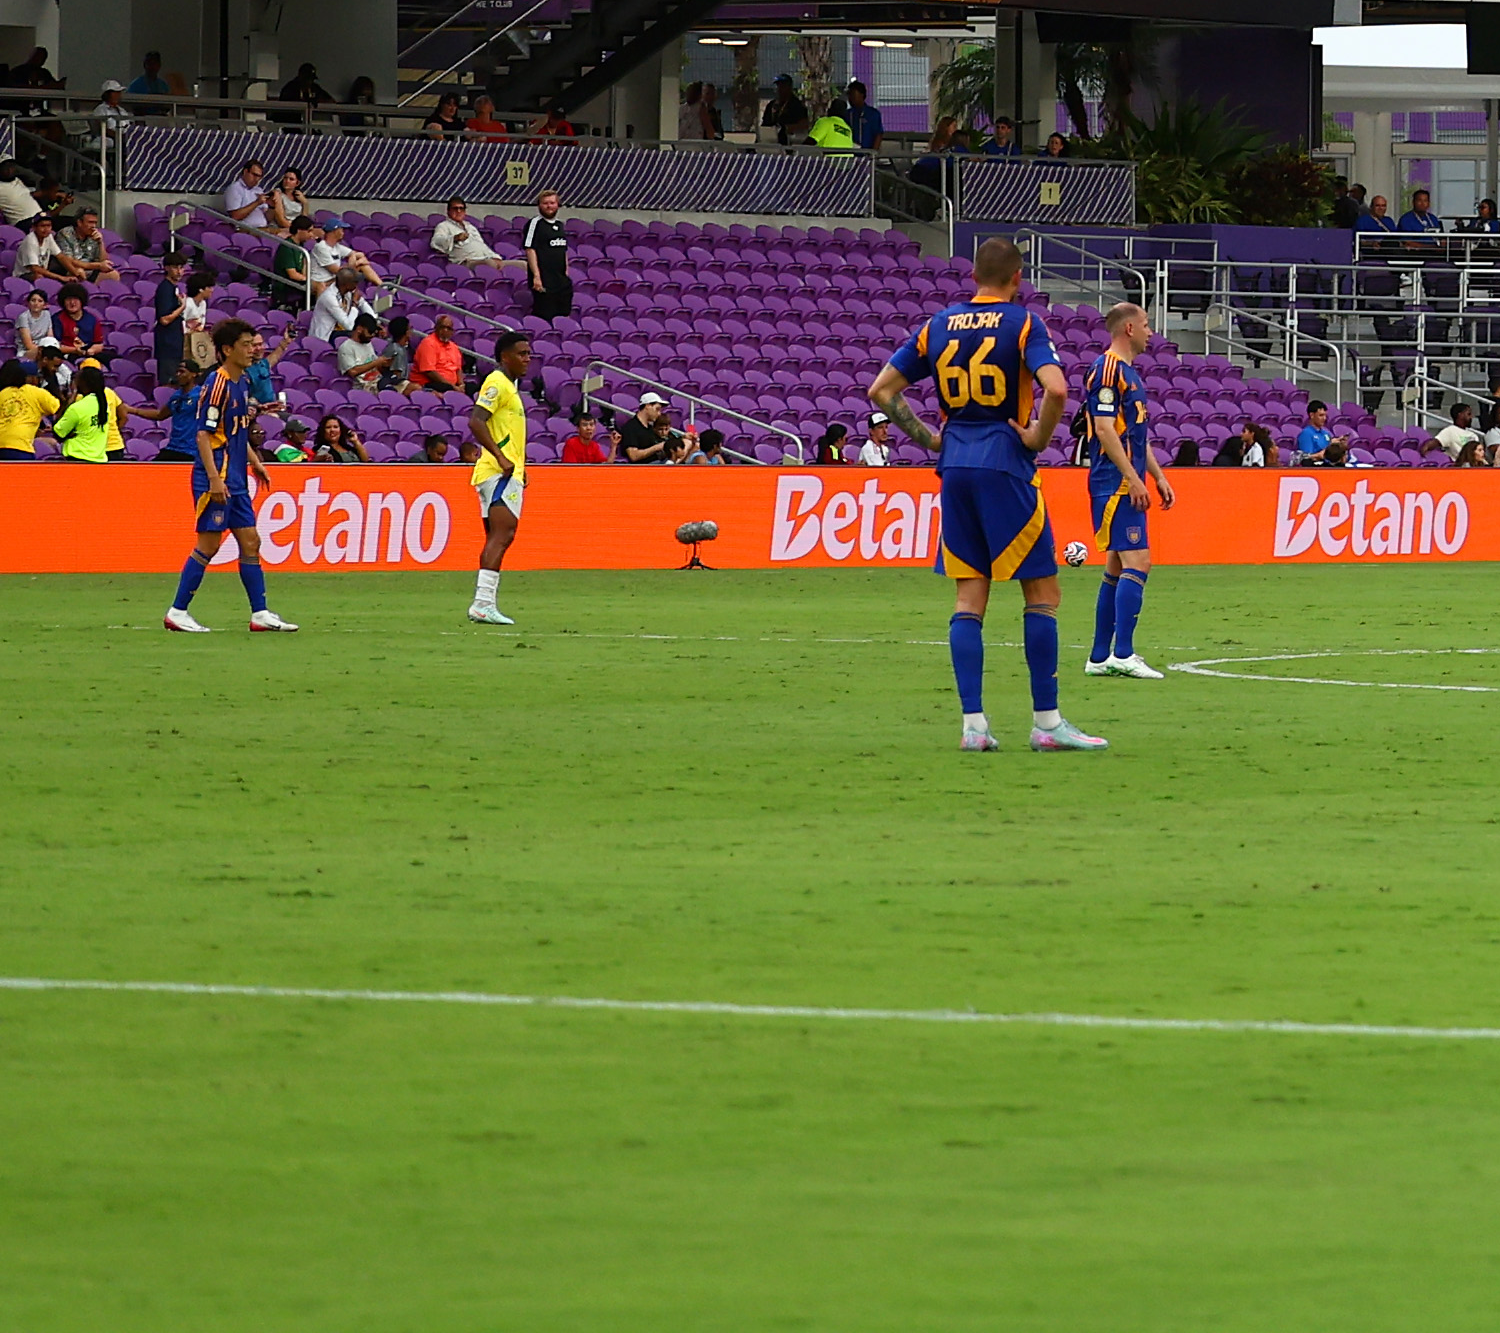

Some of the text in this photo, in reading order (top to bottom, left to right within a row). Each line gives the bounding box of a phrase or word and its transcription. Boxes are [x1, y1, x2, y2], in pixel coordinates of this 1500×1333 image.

[513, 166, 524, 181] 37
[1046, 186, 1053, 201] 1
[948, 312, 1003, 332] TROJAK
[936, 336, 1007, 409] 66
[209, 475, 450, 565] etano
[1274, 475, 1469, 557] Betano
